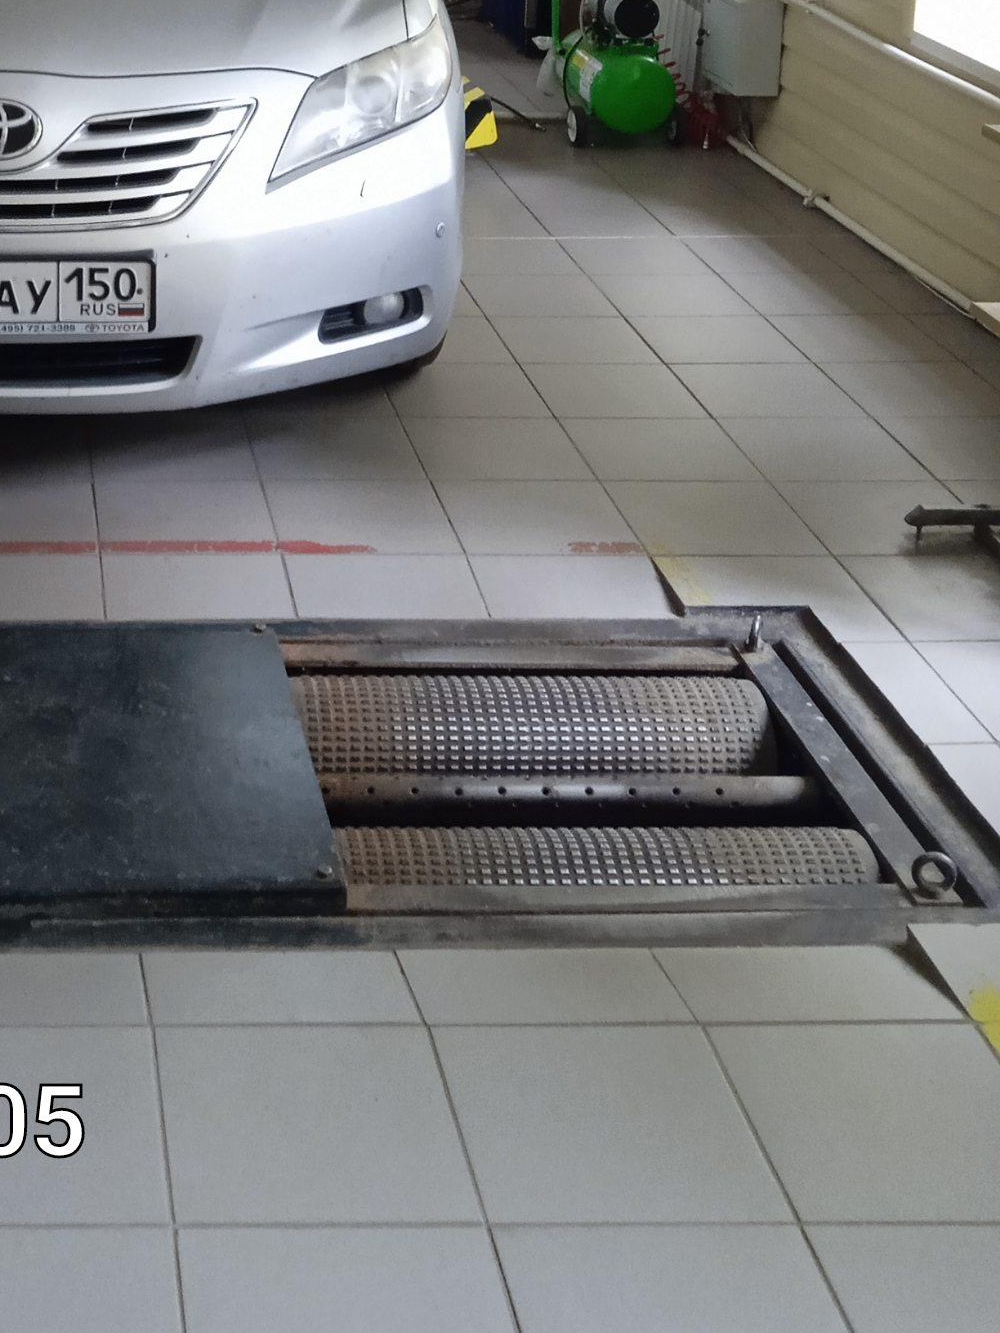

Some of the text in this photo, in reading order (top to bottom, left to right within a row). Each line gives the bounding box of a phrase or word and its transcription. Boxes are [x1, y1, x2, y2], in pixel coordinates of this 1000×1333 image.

[64, 267, 138, 301] 150
[79, 303, 116, 316] RUS
[103, 323, 145, 333] TOYOTA
